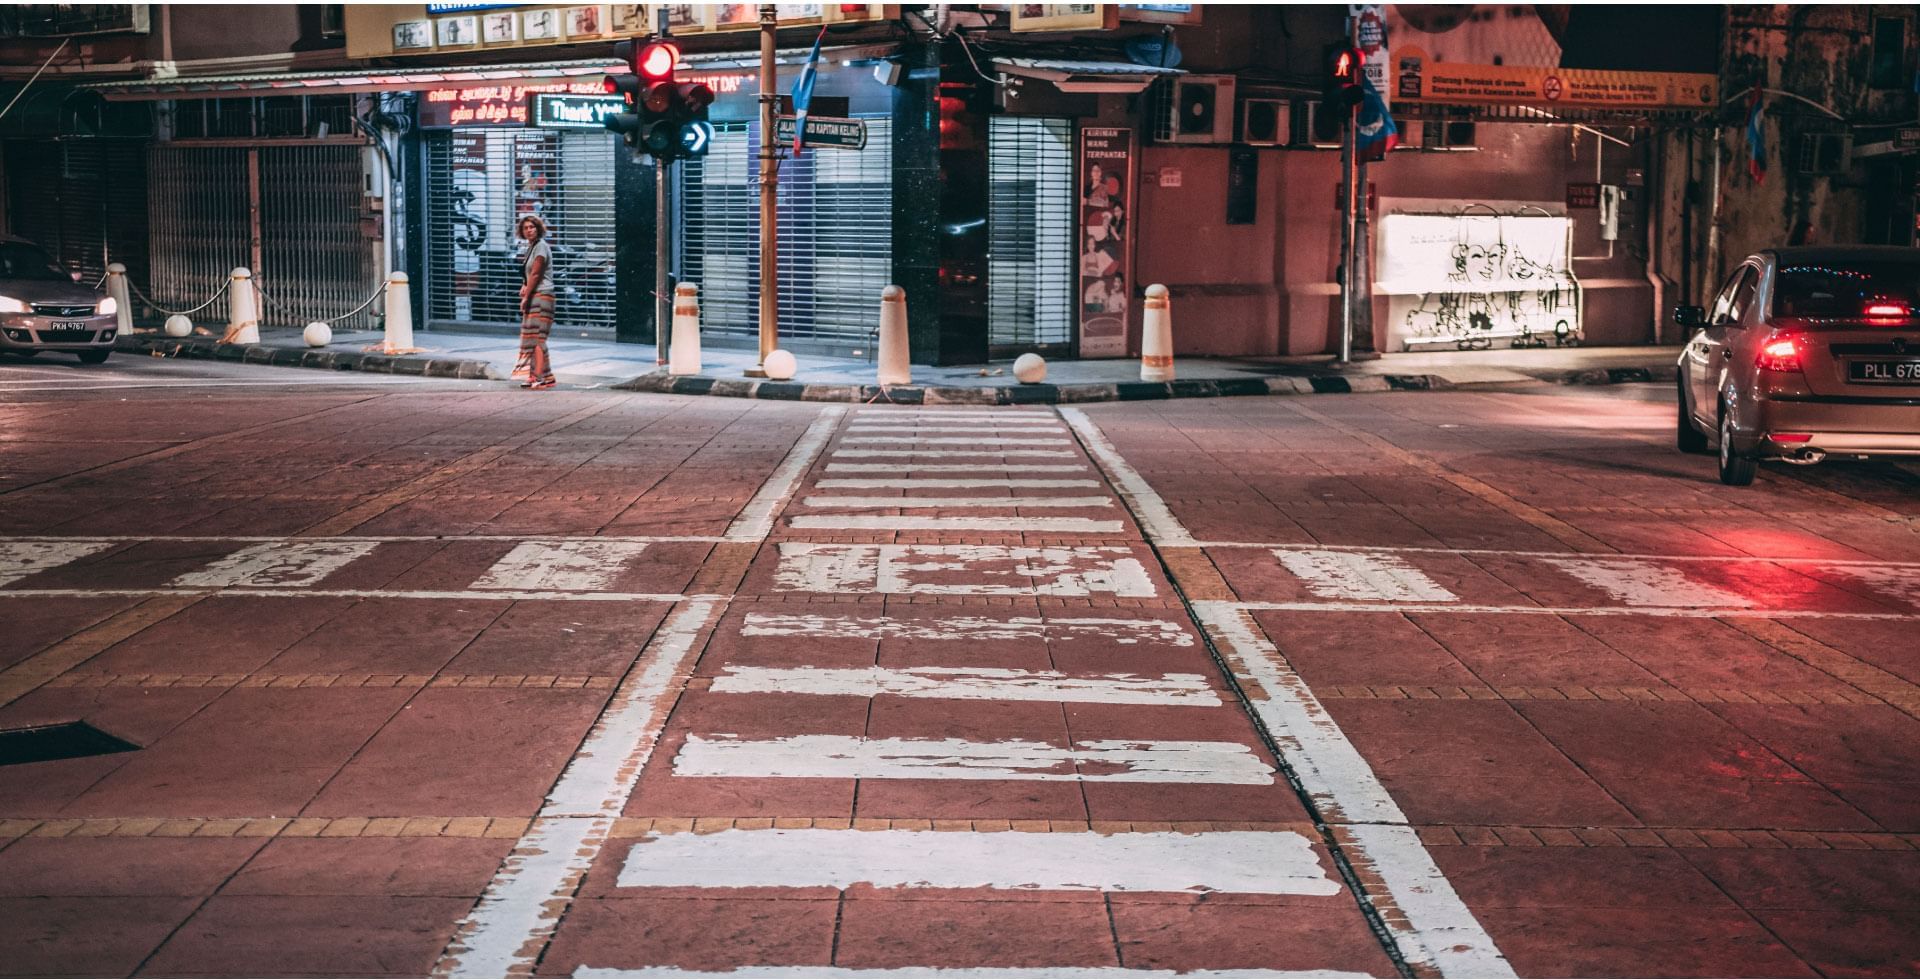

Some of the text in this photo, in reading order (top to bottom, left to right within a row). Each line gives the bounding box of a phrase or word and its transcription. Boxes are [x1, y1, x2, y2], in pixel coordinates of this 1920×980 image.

[1431, 76, 1462, 85] Dilarang
[1431, 86, 1467, 95] Bangunan
[550, 100, 594, 122] Thank
[815, 123, 839, 136] KAPITAN
[839, 125, 860, 137] KELING
[1087, 130, 1118, 138] KIRIMAN
[1087, 140, 1108, 148] WANG
[452, 147, 467, 155] ANG
[1086, 151, 1127, 159] TERPANTAS
[52, 322, 85, 330] PKH 9767
[1865, 364, 1892, 378] PLL
